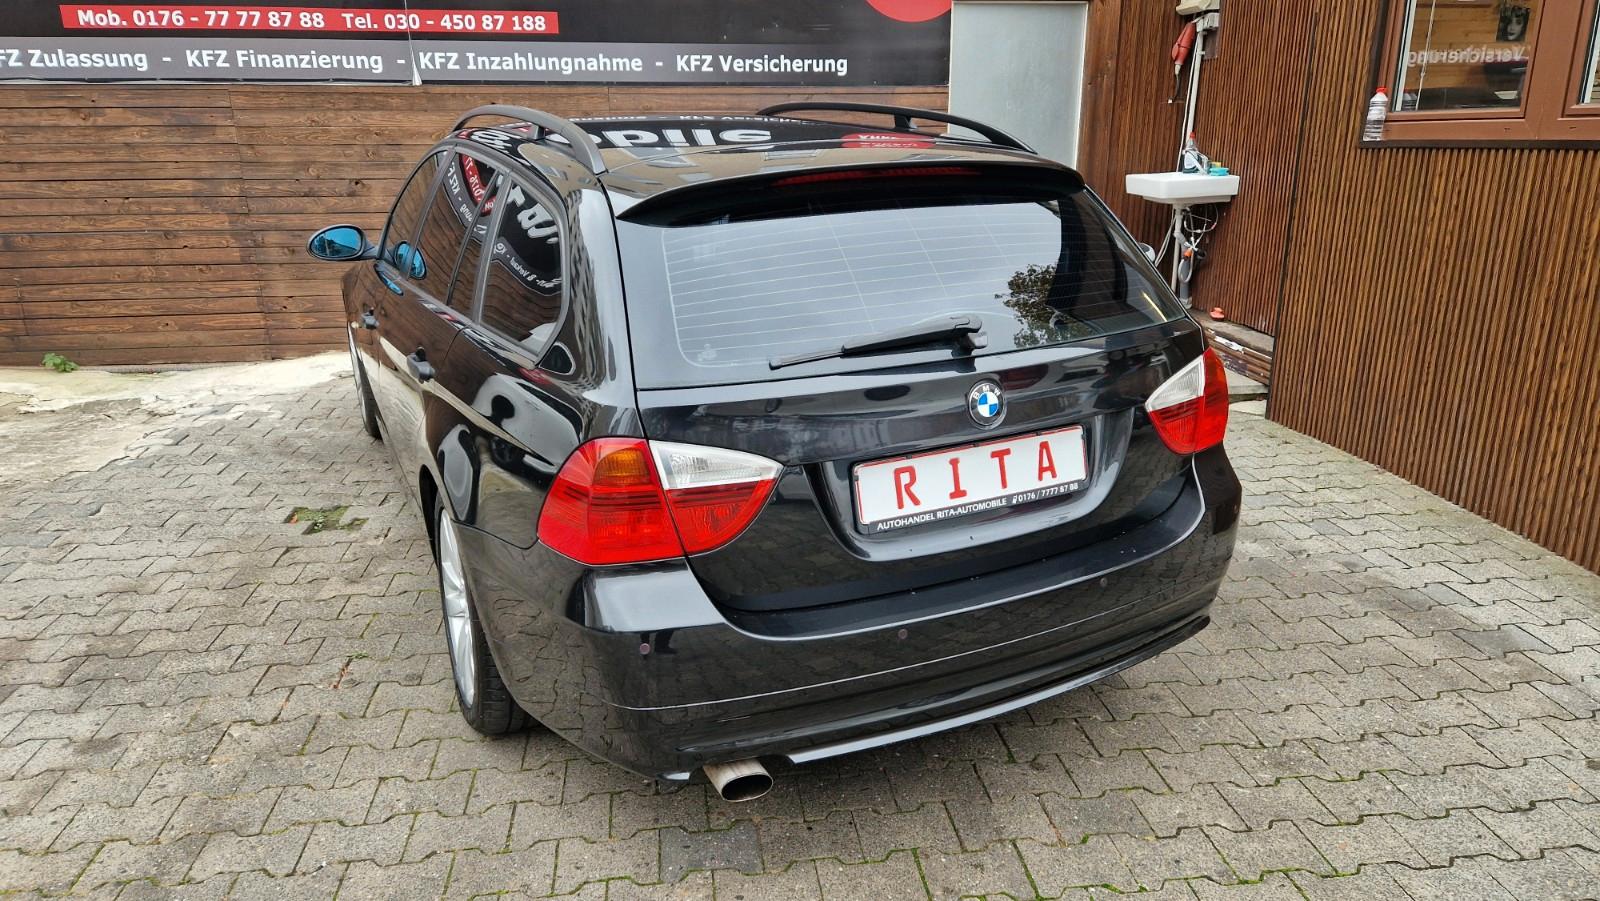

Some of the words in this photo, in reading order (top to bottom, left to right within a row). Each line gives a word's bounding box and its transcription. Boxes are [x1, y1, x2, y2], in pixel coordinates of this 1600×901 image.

[77, 9, 127, 26] Mob.
[132, 10, 184, 27] 0176
[204, 10, 229, 26] 77
[236, 10, 261, 27] 77
[267, 11, 292, 27] 87
[299, 11, 325, 28] 88
[341, 12, 378, 29] Tel.
[384, 13, 420, 30] 030
[440, 14, 476, 30] 450
[481, 14, 505, 31] 87
[511, 15, 546, 31] 188
[27, 48, 149, 72] Zulassung
[185, 49, 231, 68] KFZ
[235, 49, 384, 74] Finanzierung
[418, 51, 461, 70] KFZ
[465, 52, 643, 75] Inzahlungnahme
[676, 54, 714, 72] KFZ
[718, 54, 848, 77] Versicherung
[972, 385, 1001, 400] BMW
[893, 440, 1058, 510] RITA
[877, 513, 936, 531] AUTOHANDEL
[936, 497, 1007, 520] RITA-AUTOMOBILE
